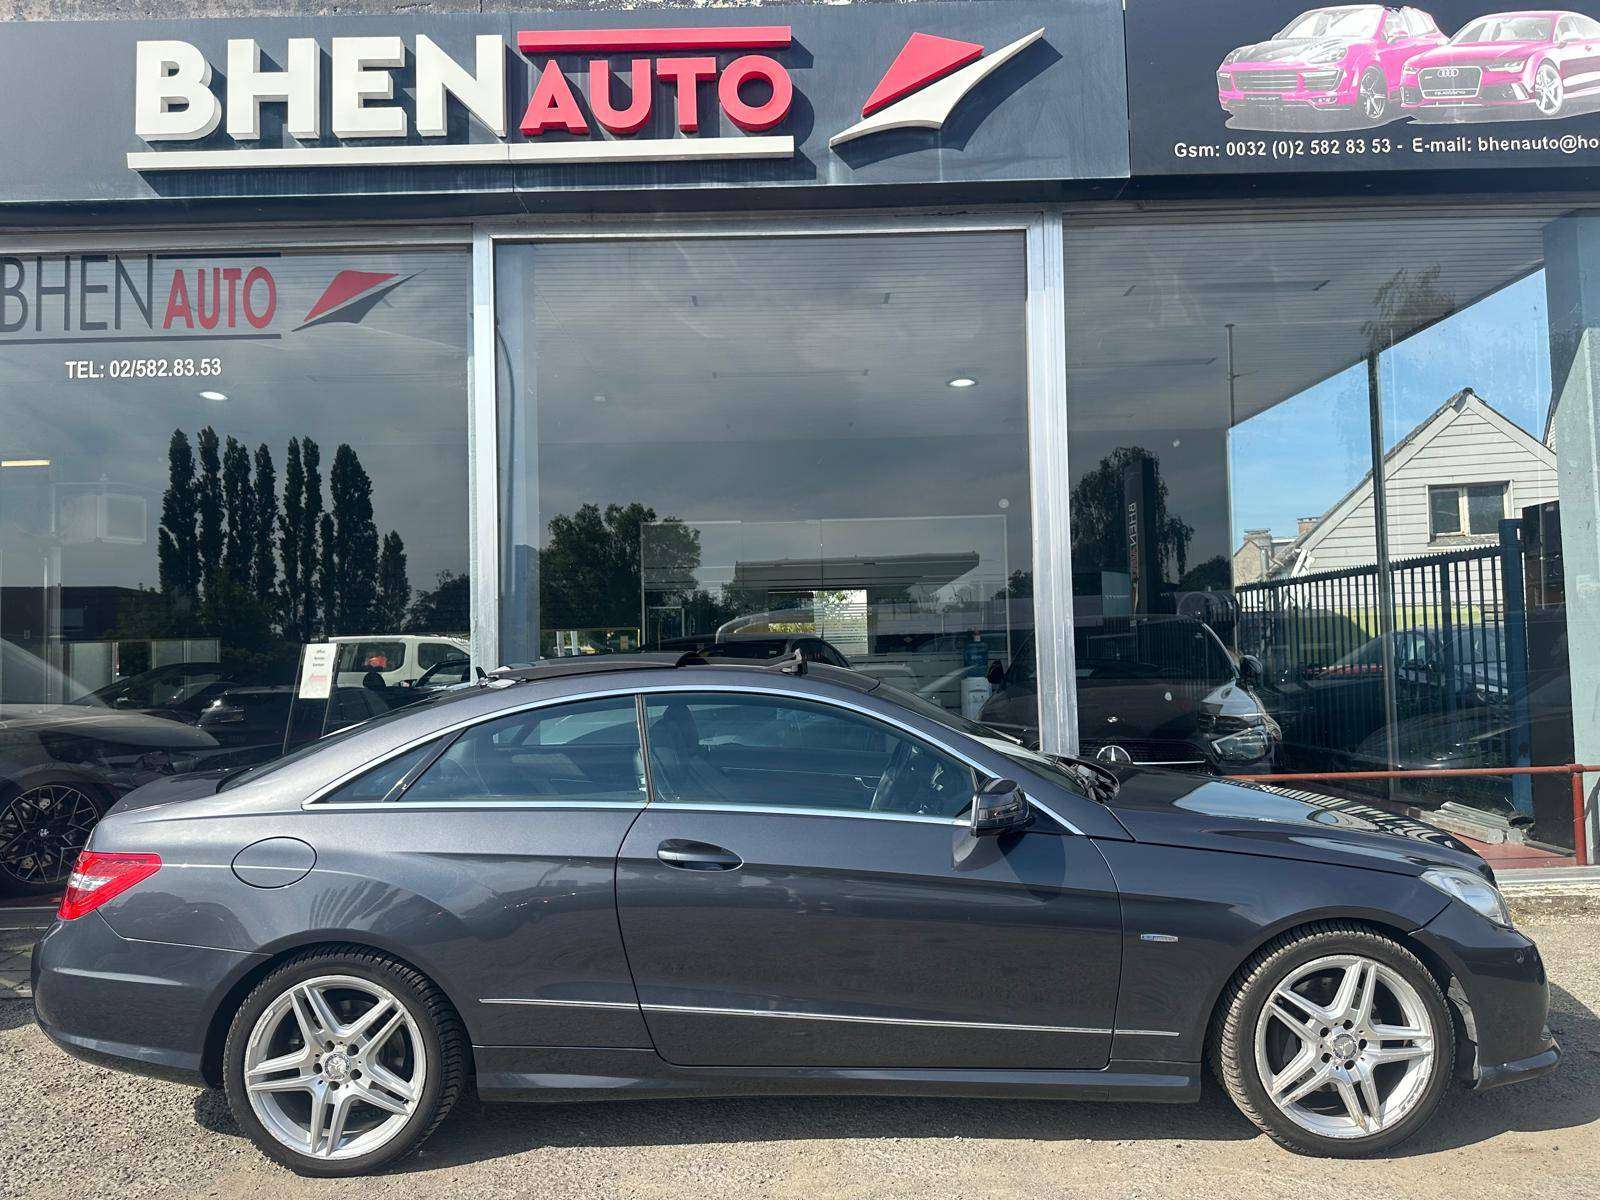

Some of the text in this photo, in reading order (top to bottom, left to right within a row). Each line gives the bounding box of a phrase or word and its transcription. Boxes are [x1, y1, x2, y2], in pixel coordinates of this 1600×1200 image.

[135, 33, 794, 142] BHEN AUTO
[1174, 142, 1220, 158] Gsm:
[1225, 141, 1266, 157] 0032
[1272, 139, 1304, 160] (0)2
[1310, 139, 1340, 155] 582
[1345, 138, 1366, 154] 83
[1371, 138, 1391, 154] 53
[1412, 136, 1472, 153] E-mail:
[0, 253, 277, 333] BHEN AUTO
[64, 358, 222, 379] TEL: 02/582.83.53
